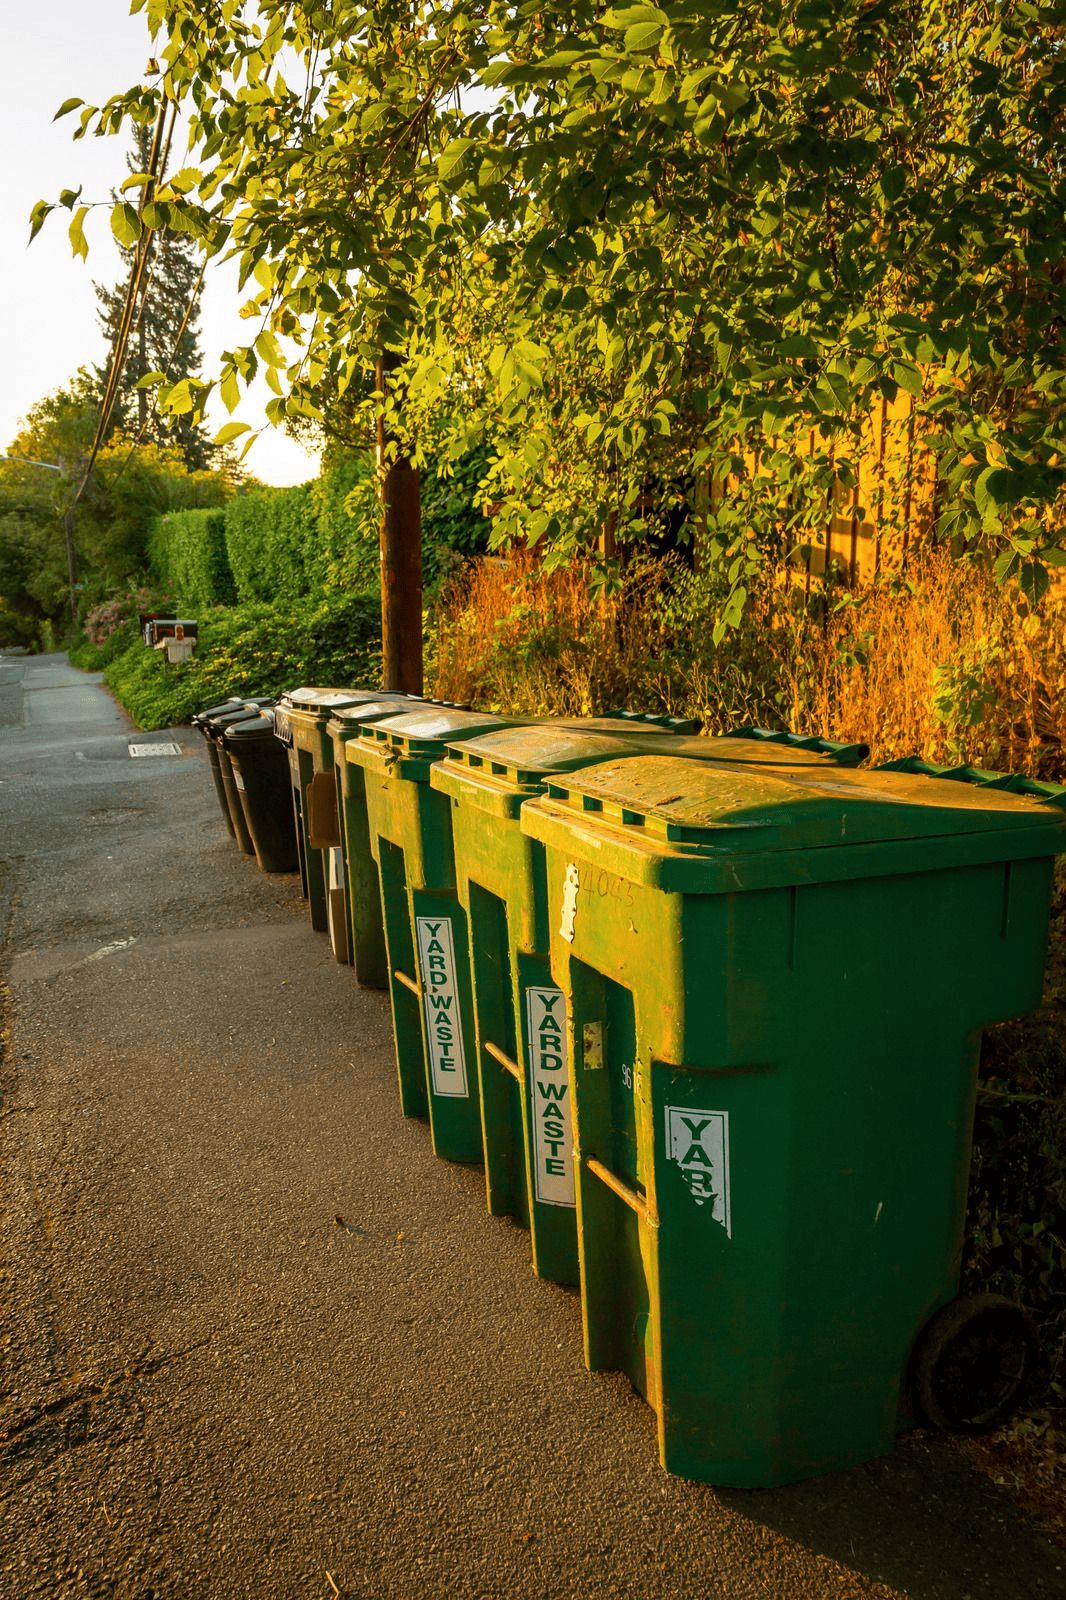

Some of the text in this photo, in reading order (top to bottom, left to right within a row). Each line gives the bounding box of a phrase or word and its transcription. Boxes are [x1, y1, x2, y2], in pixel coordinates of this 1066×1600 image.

[424, 922, 456, 1072] YARD WASTE
[536, 994, 568, 1176] YARD WASTE
[680, 1116, 714, 1200] YAR
